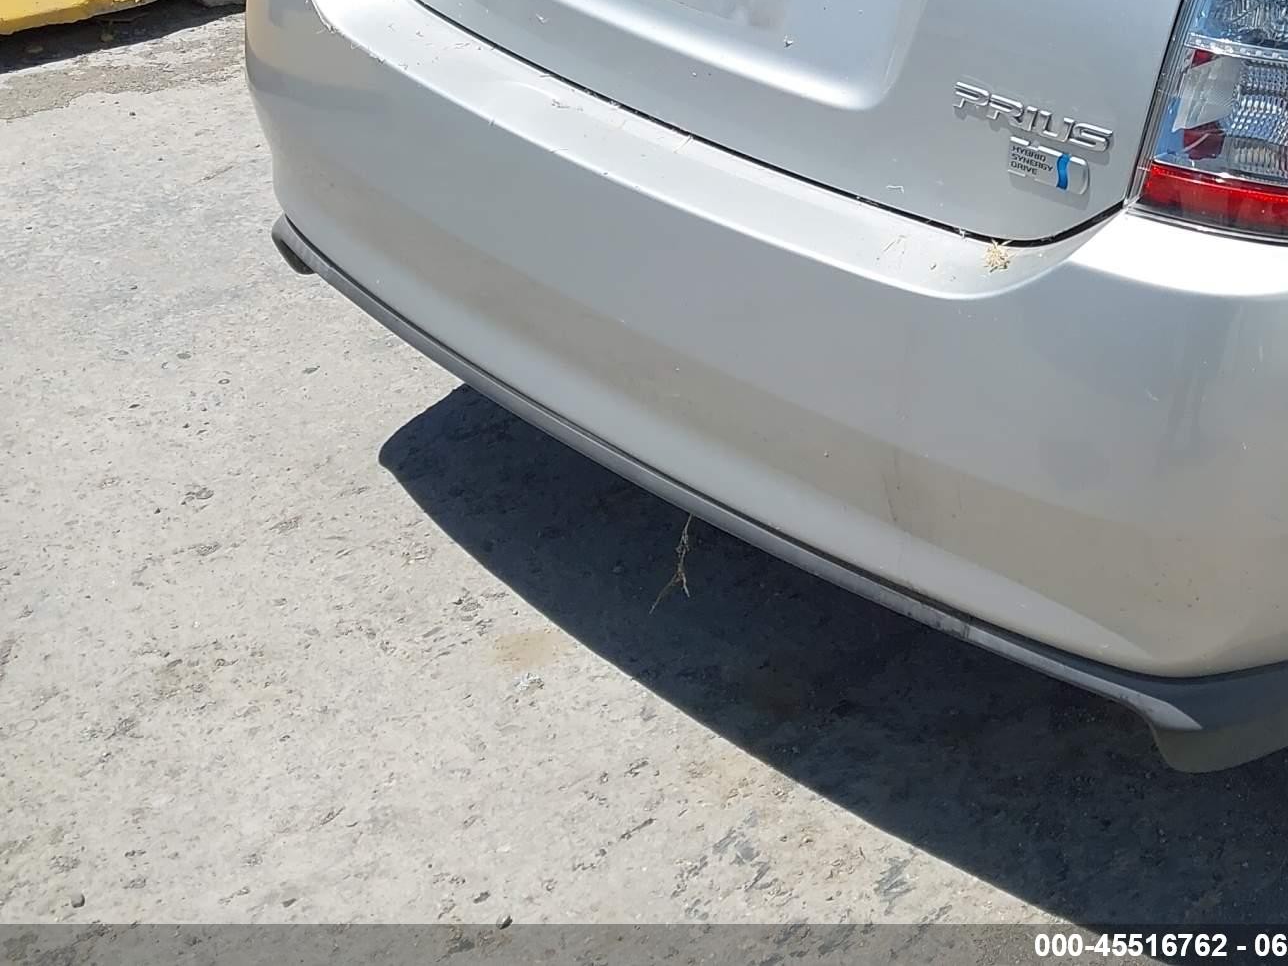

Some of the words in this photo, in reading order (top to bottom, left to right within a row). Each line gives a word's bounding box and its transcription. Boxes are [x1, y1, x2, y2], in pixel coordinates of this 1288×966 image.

[953, 80, 1114, 153] PRIUS
[1011, 145, 1047, 163] HYBRID
[1011, 153, 1054, 172] SYNERGY
[1010, 160, 1038, 176] DRIVE
